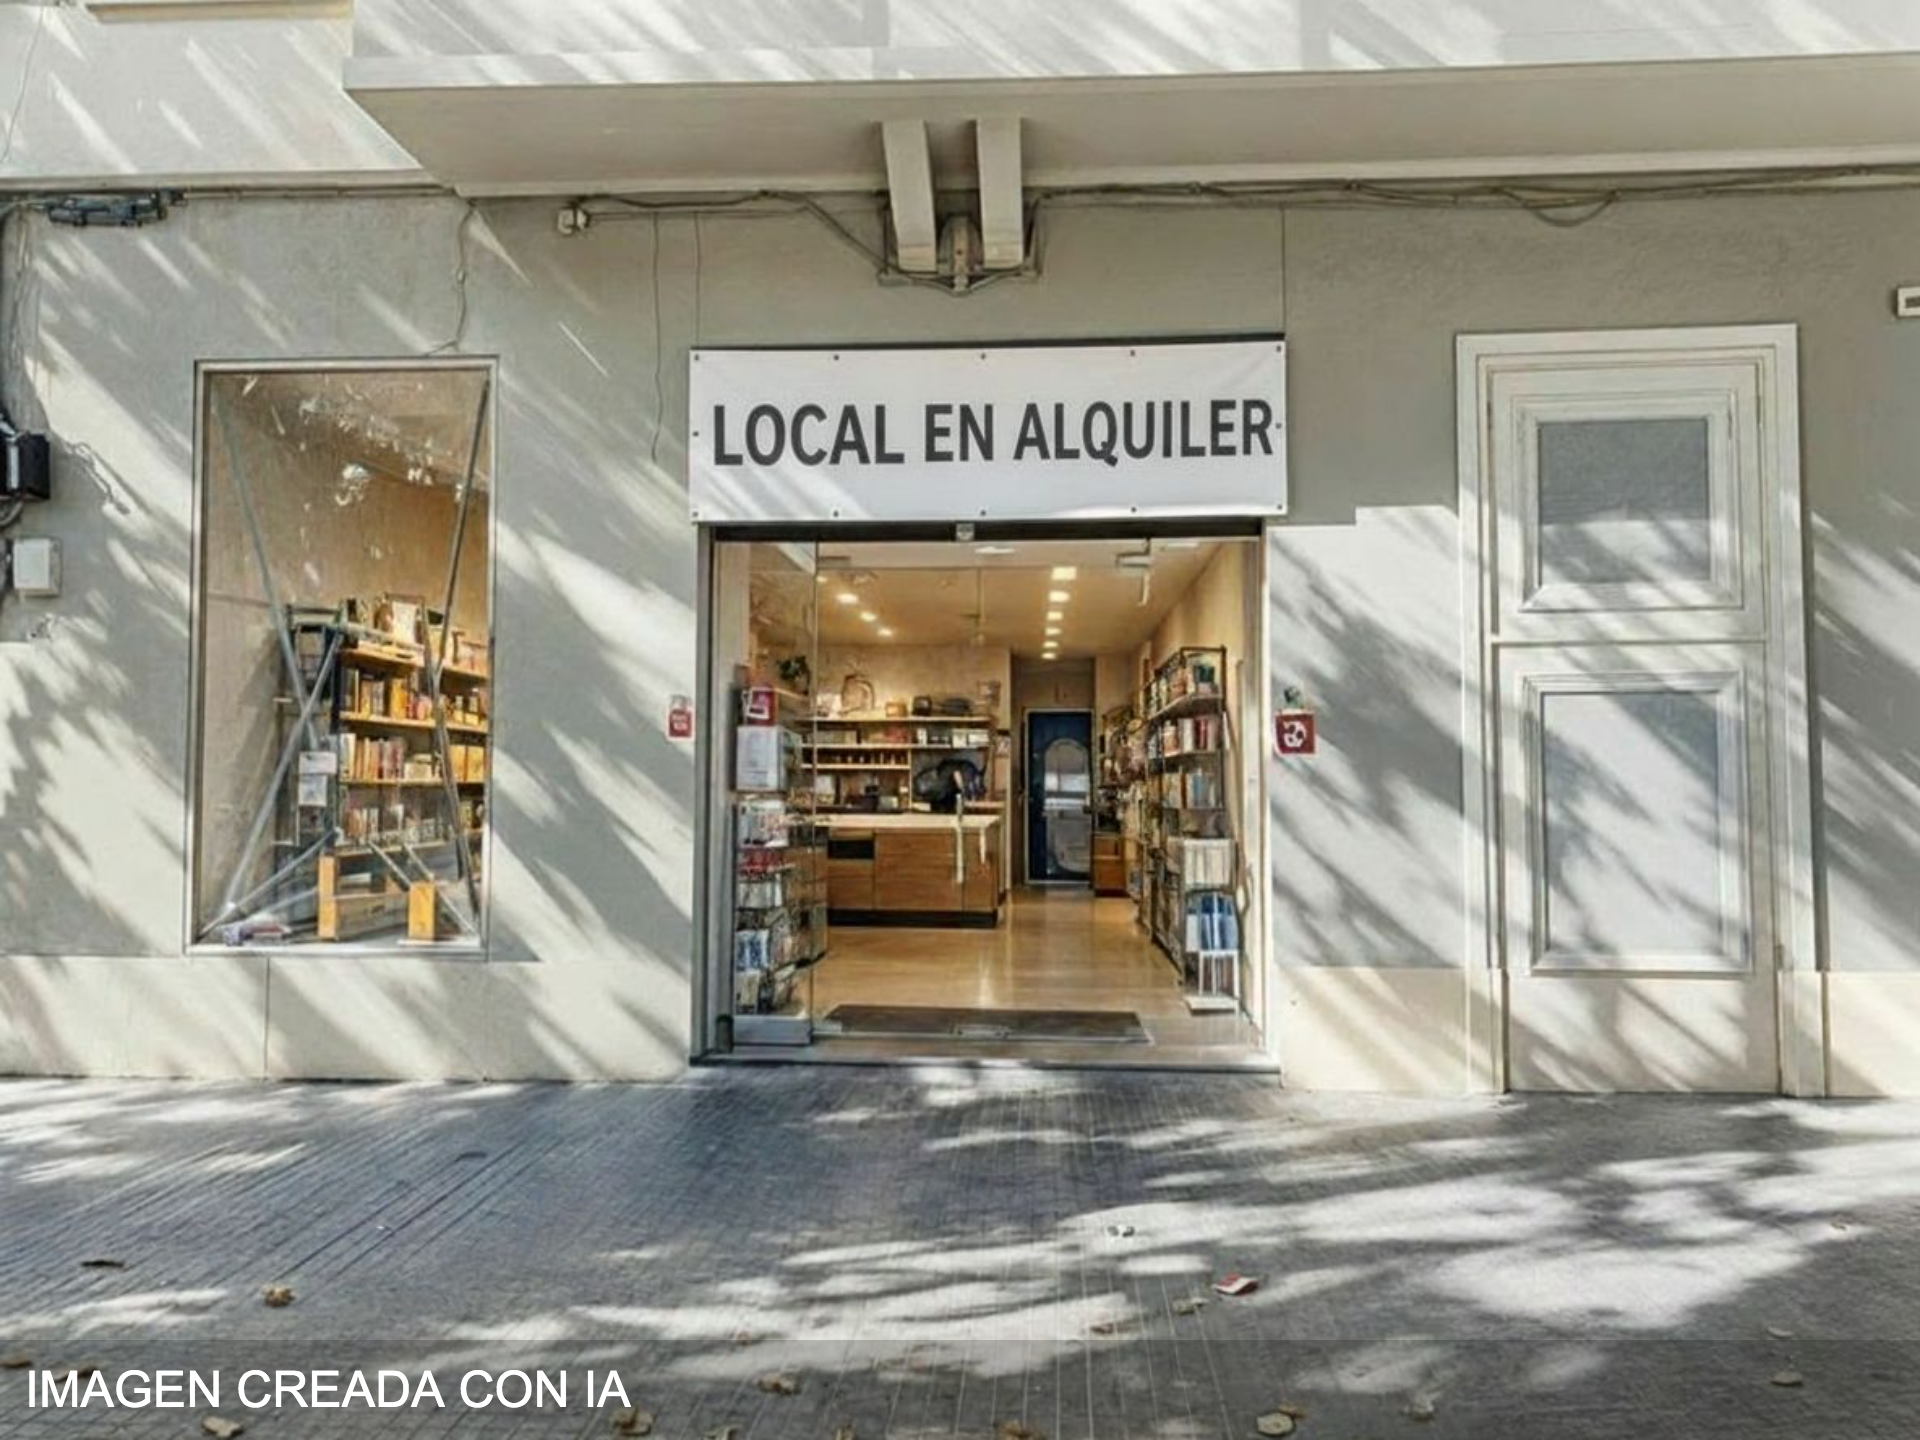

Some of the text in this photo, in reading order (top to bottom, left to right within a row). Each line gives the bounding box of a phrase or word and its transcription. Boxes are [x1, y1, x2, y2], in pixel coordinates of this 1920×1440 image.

[715, 400, 1272, 466] LOCAL EN ALQUILER
